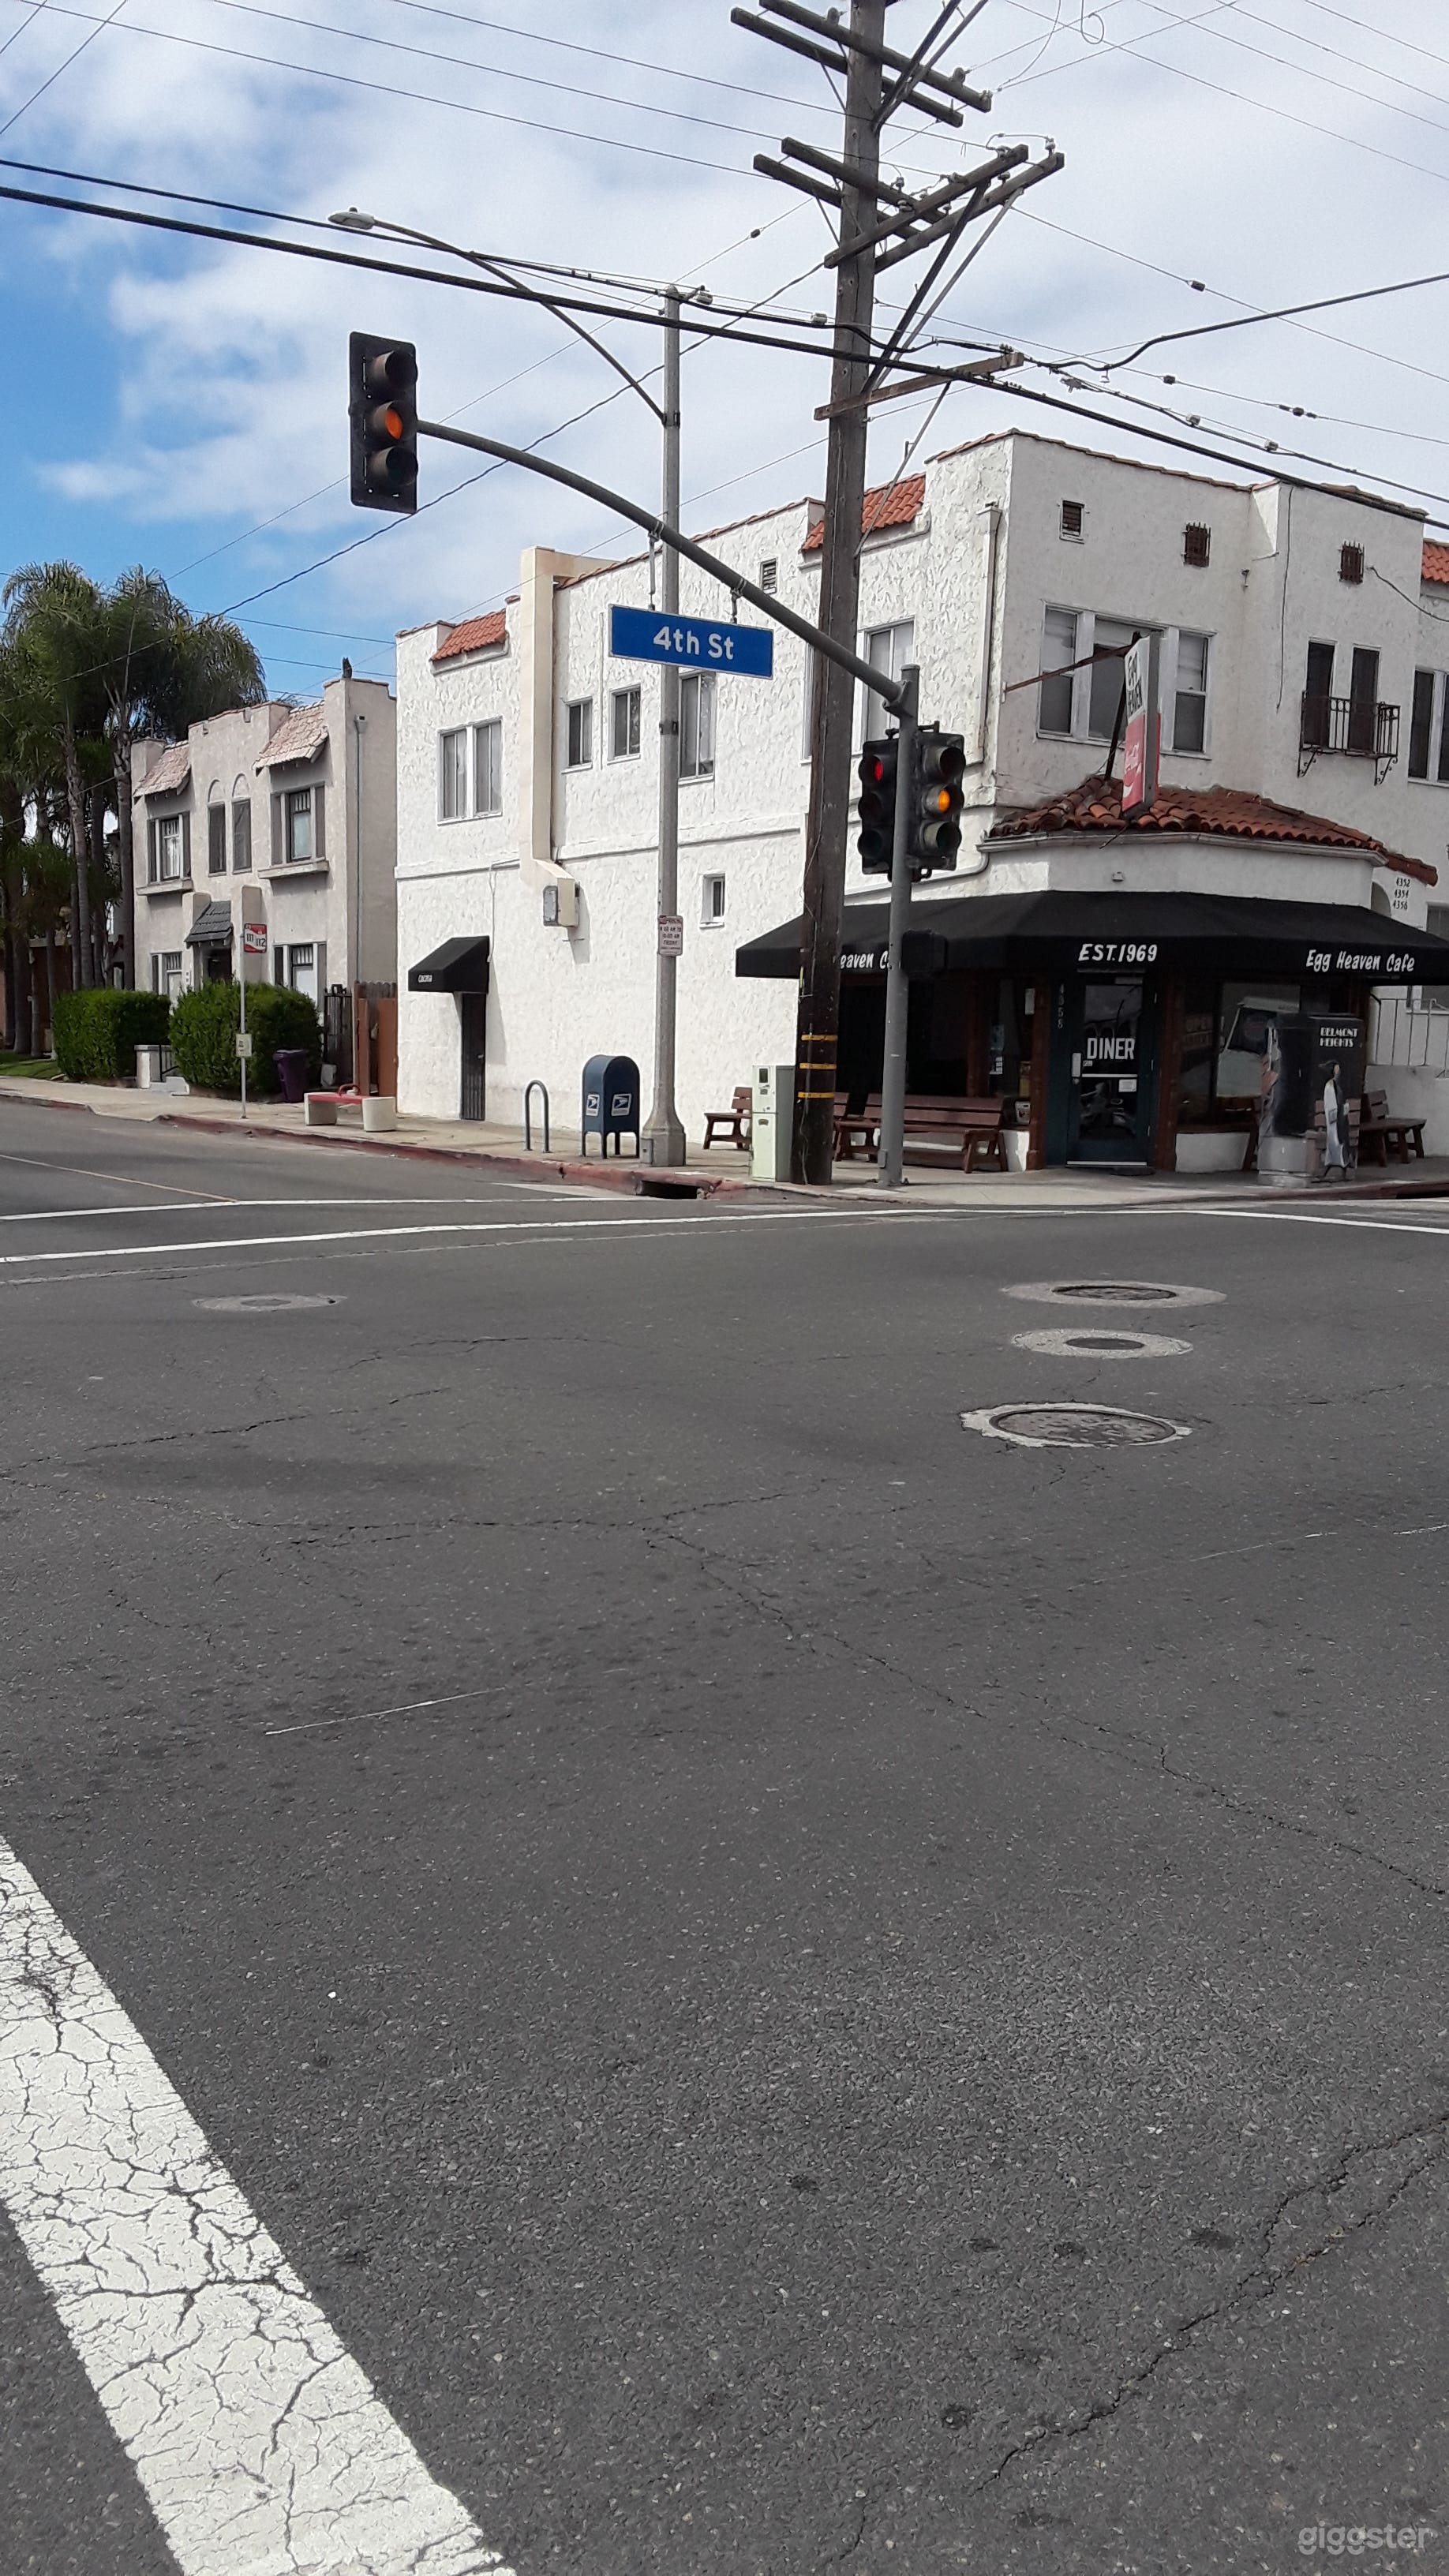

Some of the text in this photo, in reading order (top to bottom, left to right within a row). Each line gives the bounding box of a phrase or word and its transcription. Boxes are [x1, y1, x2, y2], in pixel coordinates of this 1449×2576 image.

[653, 626, 734, 661] 4th St
[1396, 878, 1410, 887] 4352
[1394, 889, 1409, 899] 4354
[1392, 900, 1408, 910] 4356
[256, 938, 266, 947] 112
[840, 953, 874, 969] eaven
[1305, 949, 1415, 972] Egg Heaven Cafe
[1320, 1027, 1357, 1037] BELMONT
[1320, 1037, 1354, 1048] HEIGHTS
[1087, 1037, 1136, 1060] DINER
